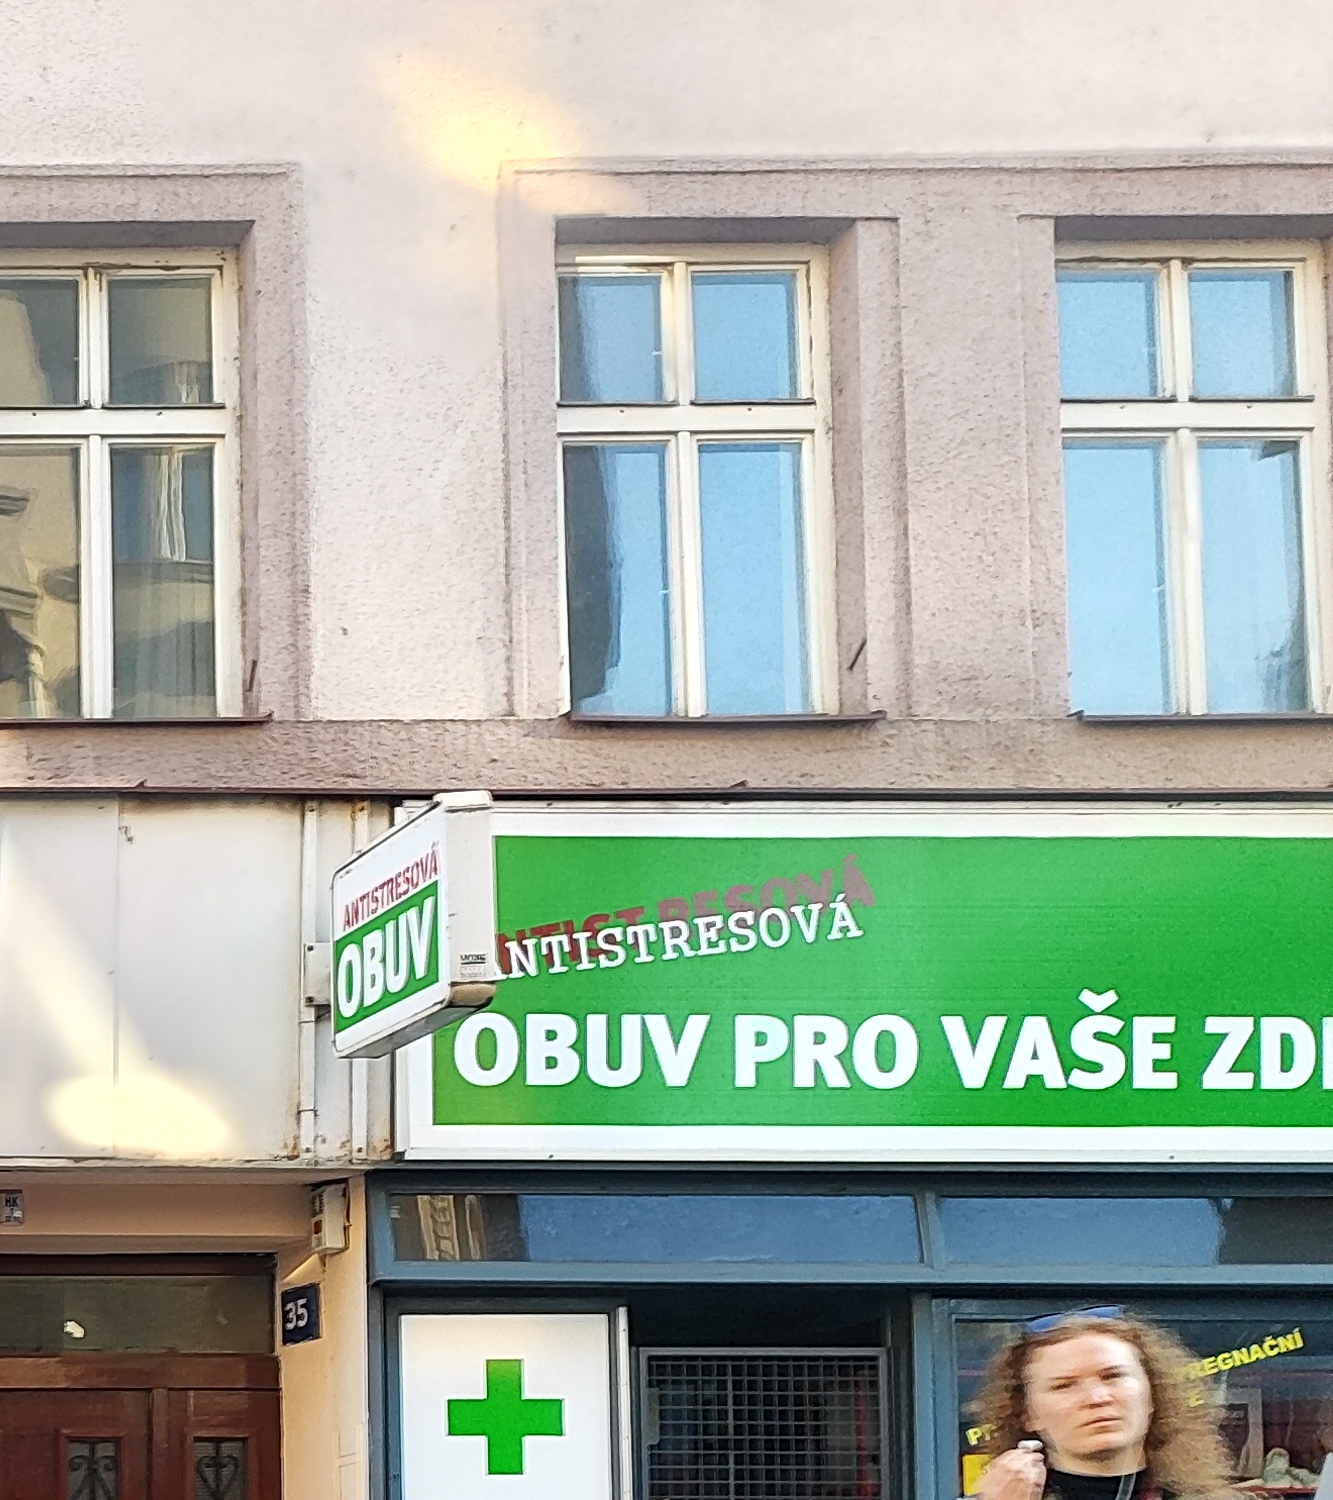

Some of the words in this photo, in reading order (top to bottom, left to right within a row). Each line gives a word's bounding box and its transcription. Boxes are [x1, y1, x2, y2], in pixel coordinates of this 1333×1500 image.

[343, 841, 440, 932] ANTISTRESOVÁ
[337, 895, 437, 1018] OBUV
[453, 1012, 710, 1089] OBUV
[734, 1013, 920, 1089] PRO
[940, 988, 1178, 1090] VAŠE
[1201, 1015, 1333, 1090] ZD
[284, 1297, 309, 1331] 35
